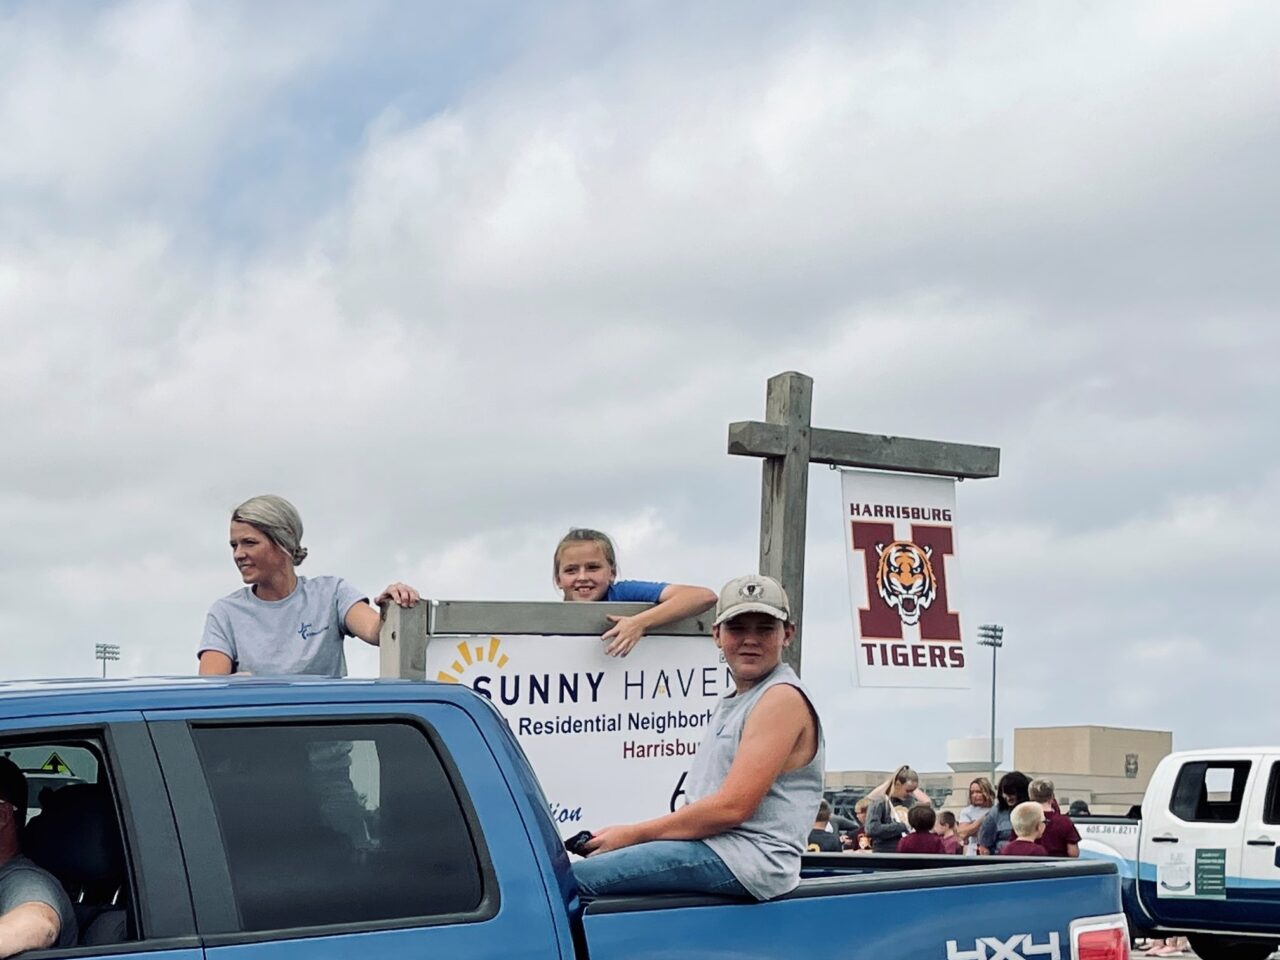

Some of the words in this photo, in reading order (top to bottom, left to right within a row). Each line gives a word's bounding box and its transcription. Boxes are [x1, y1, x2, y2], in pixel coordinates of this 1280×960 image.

[850, 503, 952, 521] HARRISBURG
[861, 643, 965, 668] TIGERS
[473, 671, 605, 706] SUNNY
[518, 713, 622, 736] Residential
[623, 738, 701, 759] Harrisbu
